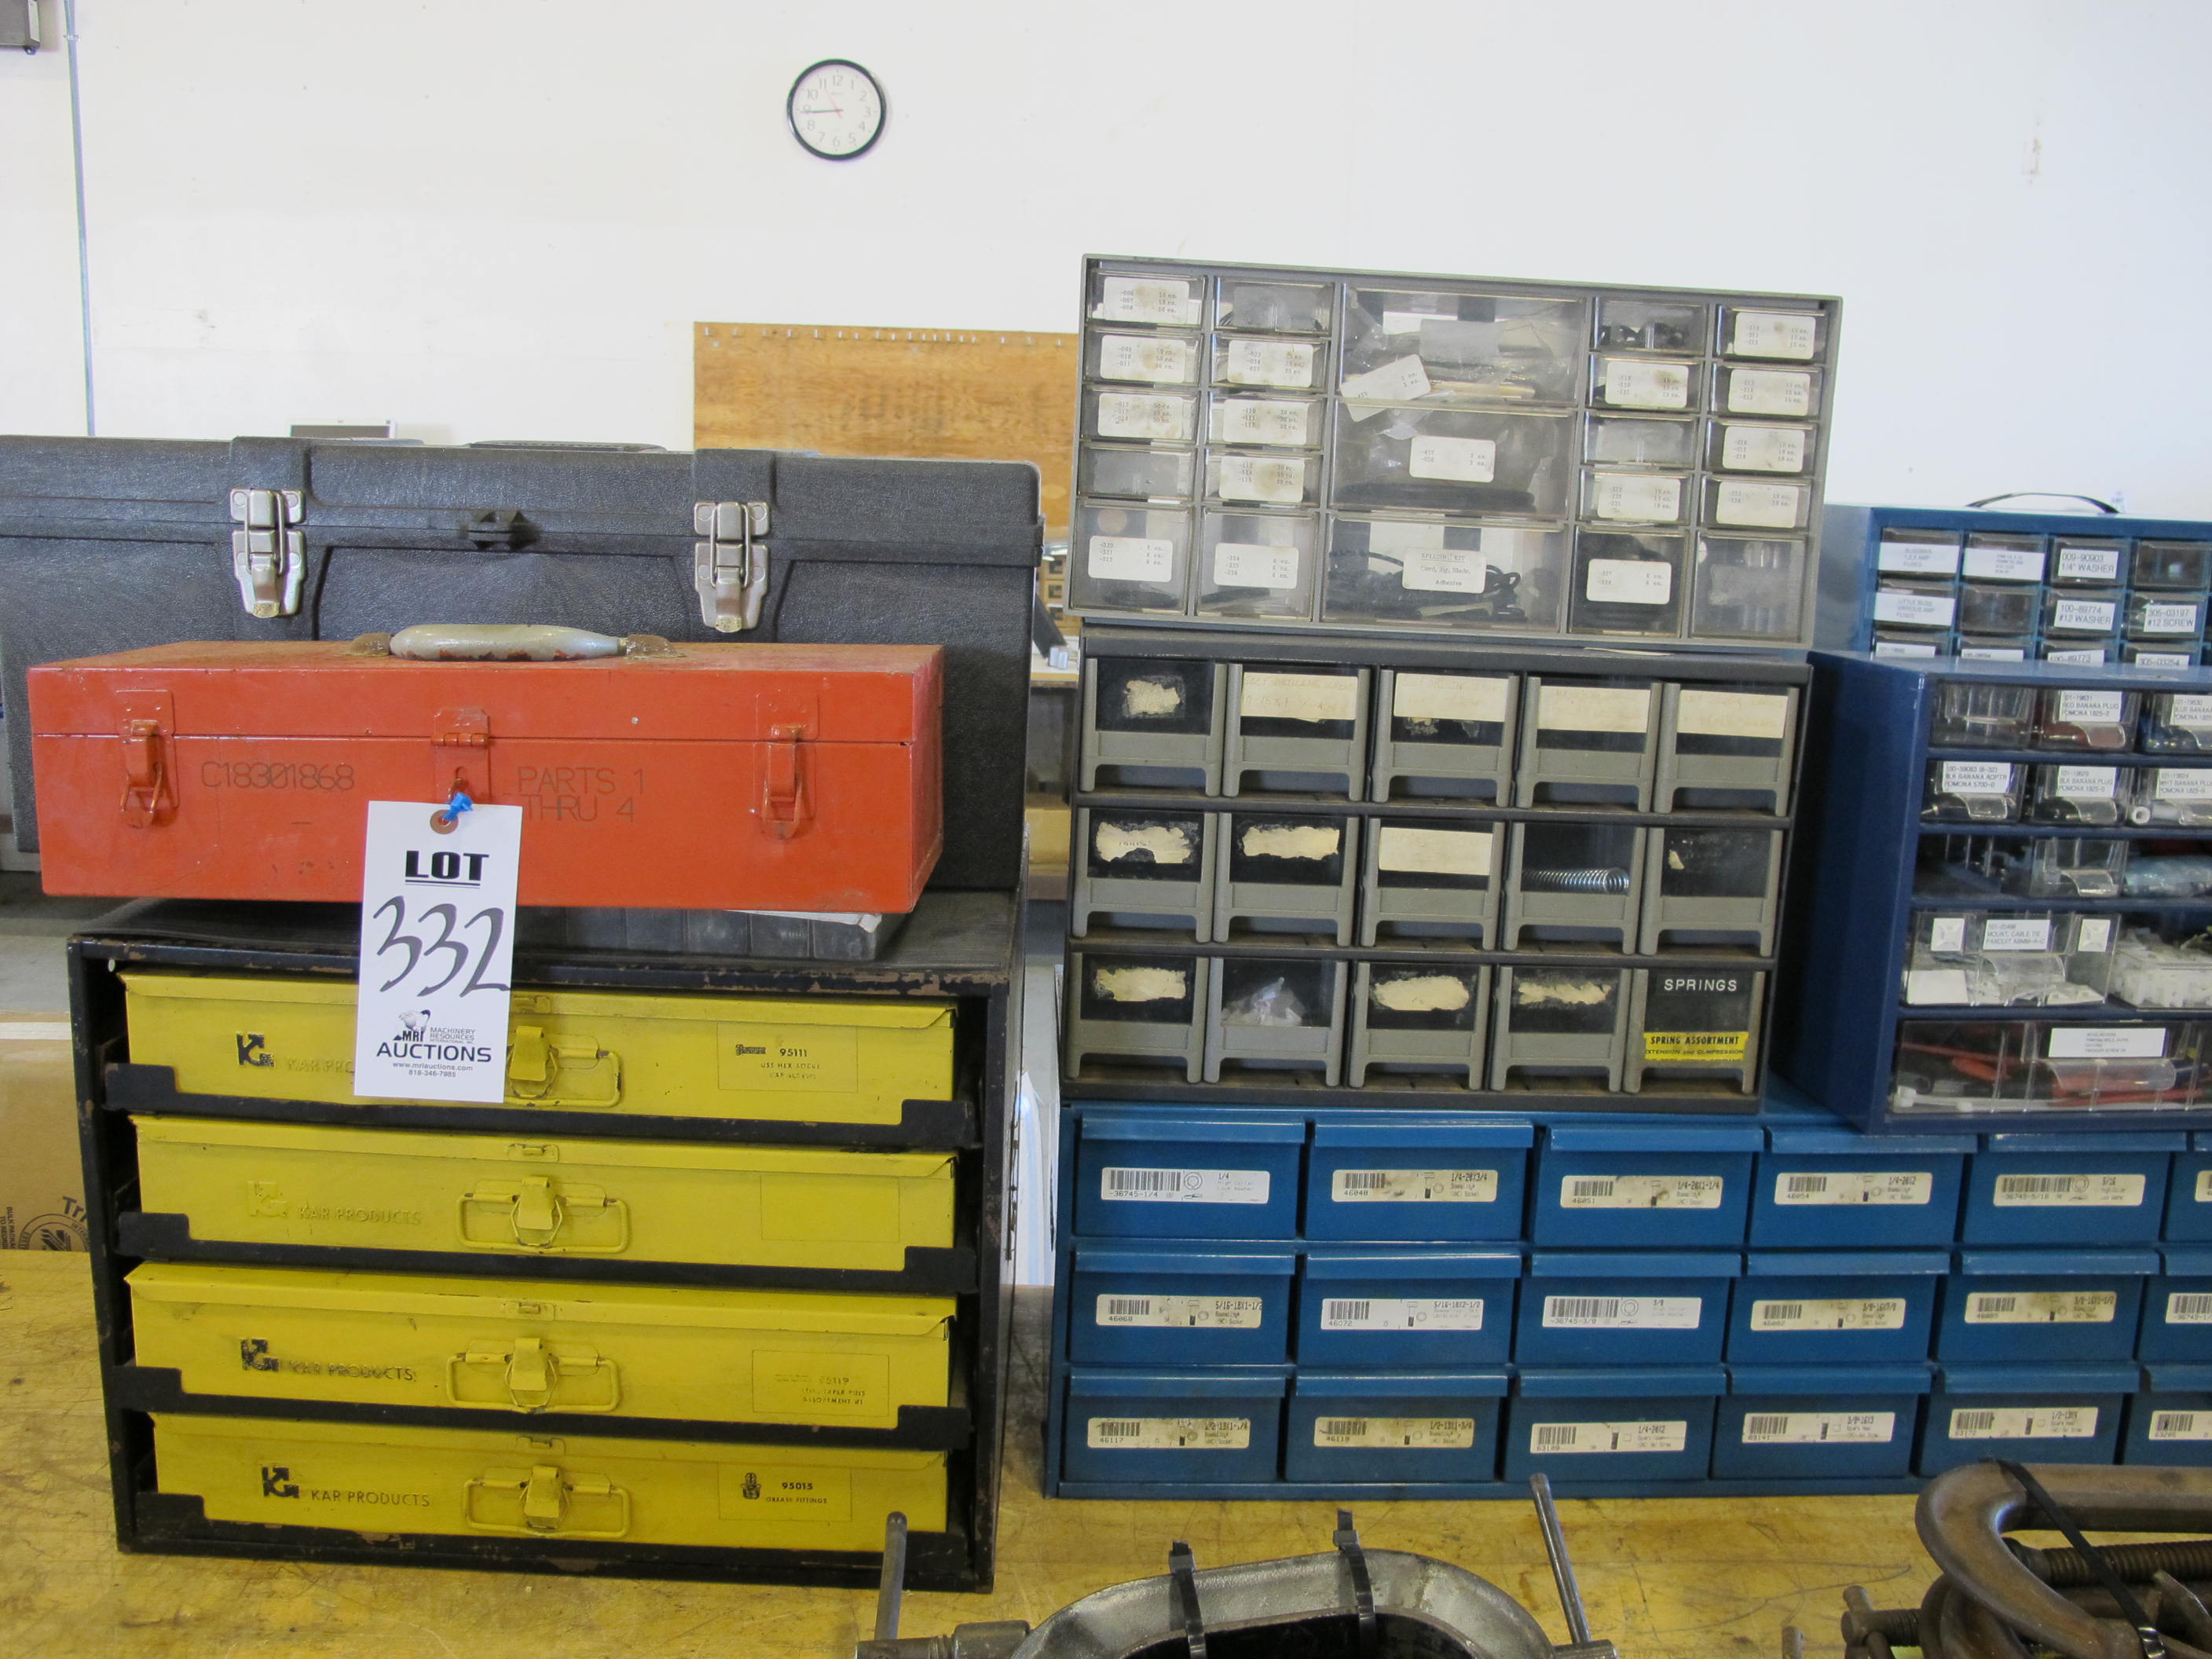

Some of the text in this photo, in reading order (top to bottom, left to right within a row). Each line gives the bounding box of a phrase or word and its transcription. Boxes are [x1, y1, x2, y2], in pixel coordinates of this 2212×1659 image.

[819, 78, 826, 89] 11
[833, 75, 844, 86] 12
[807, 89, 819, 101] 10
[859, 90, 867, 101] 2
[865, 106, 871, 118] 3
[808, 119, 815, 130] 8
[859, 121, 866, 132] 4
[819, 132, 825, 142] 7
[833, 136, 840, 147] 6
[848, 132, 856, 144] 5
[2078, 563, 2115, 573] WASHER
[2075, 615, 2111, 624] WASHER
[2163, 618, 2193, 627] SCREW
[201, 760, 355, 790] C18301868
[518, 766, 644, 795] PARTS 1
[518, 793, 635, 822] THRU 4
[405, 850, 489, 881] LOT
[372, 895, 511, 998] 332
[1664, 979, 1738, 991] SPRINGS
[402, 1030, 424, 1042] MRI
[430, 1027, 475, 1035] MACHINERY
[1650, 1036, 1739, 1045] SPRING ASSORTMENT
[375, 1042, 492, 1063] AUCTIONS
[779, 1048, 808, 1057] 95111
[393, 1062, 473, 1071] www.mriauctions.com
[335, 1207, 422, 1225] PRODUCTS
[328, 1362, 414, 1382] PRODUCTS
[782, 1481, 814, 1490] 95015
[311, 1489, 430, 1507] KAR PRODUCTS
